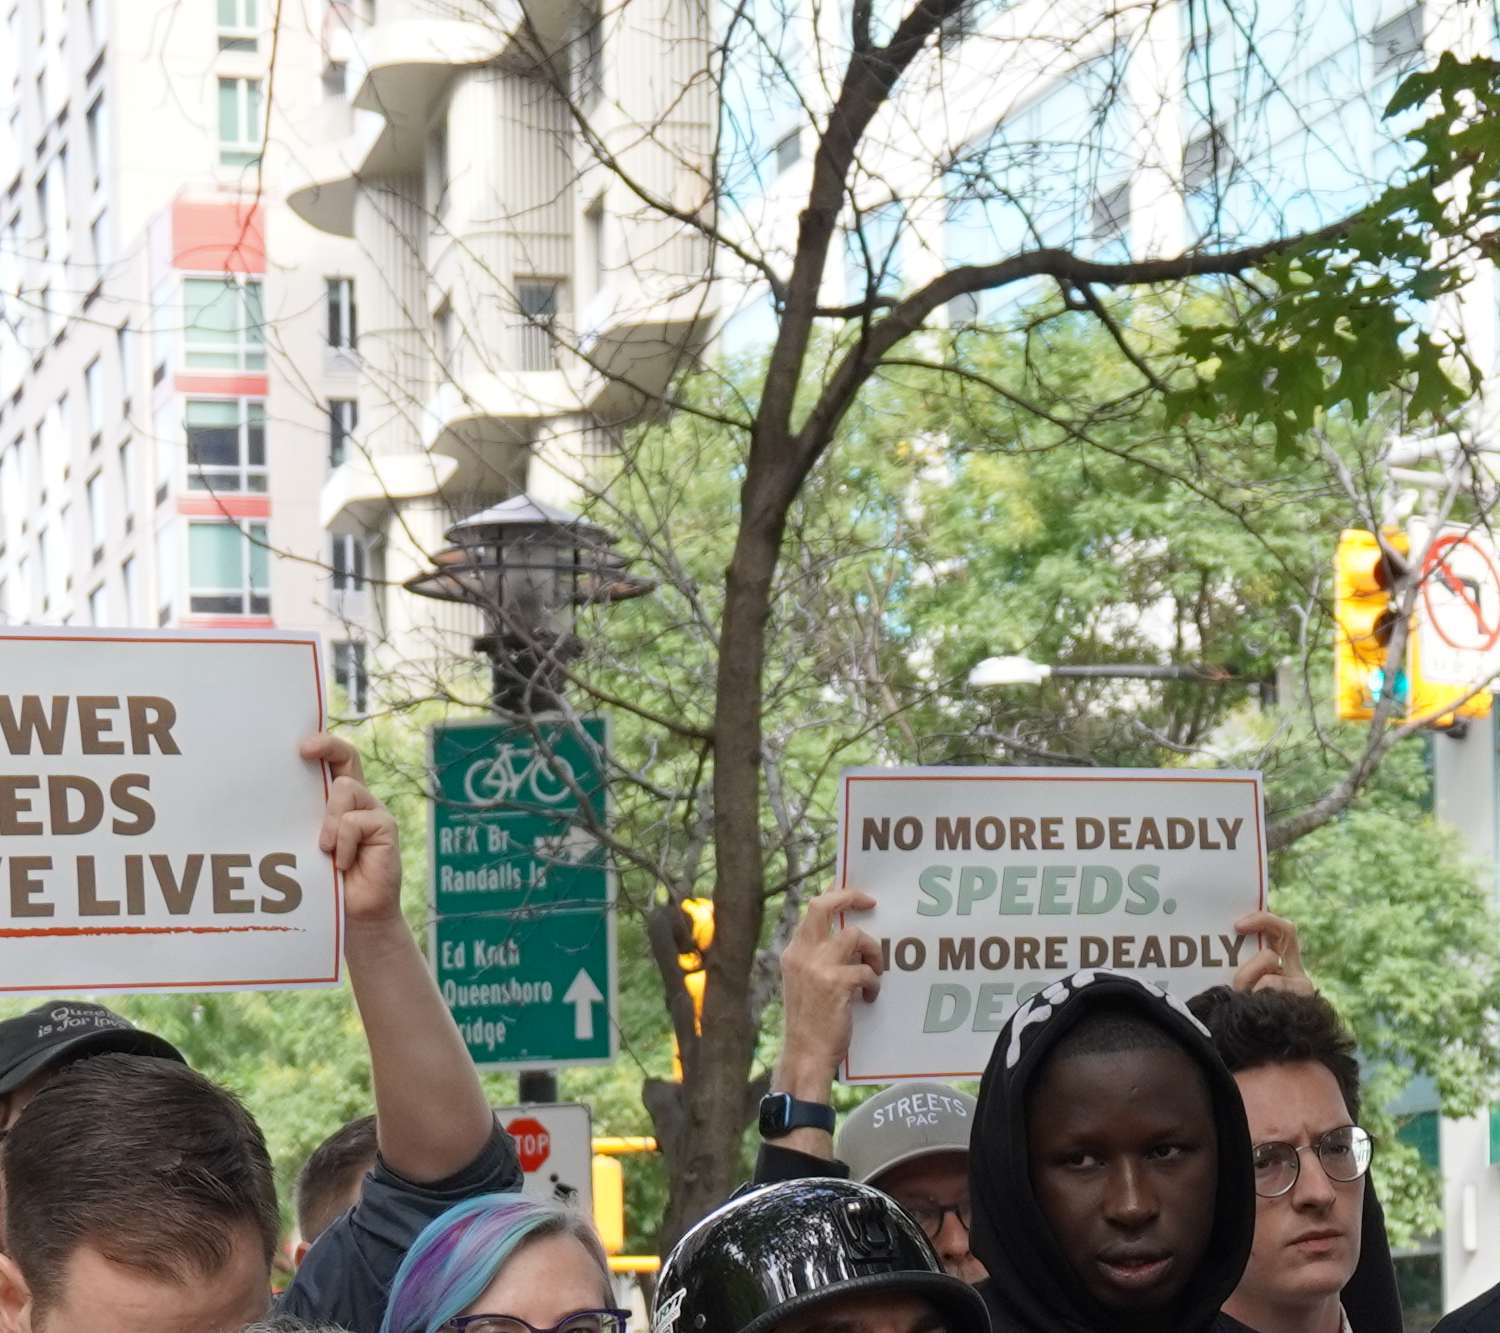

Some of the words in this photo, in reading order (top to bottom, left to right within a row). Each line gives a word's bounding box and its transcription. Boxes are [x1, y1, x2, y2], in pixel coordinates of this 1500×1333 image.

[862, 816, 923, 851] NO
[935, 816, 1064, 851] MORE
[1075, 817, 1244, 851] DEADLY
[76, 852, 303, 916] LIVES
[440, 863, 520, 892] Randalls
[917, 864, 1177, 917] SPEEDS.
[441, 940, 466, 969] Ed
[938, 936, 1068, 972] MORE
[1080, 935, 1248, 969] DEADLY
[443, 978, 553, 1007] Queensboro
[38, 1025, 52, 1038] is
[57, 1017, 90, 1031] for
[459, 1016, 506, 1051] ridge
[872, 1093, 967, 1129] STREETS
[905, 1112, 938, 1128] PAC
[515, 1133, 548, 1155] TOP
